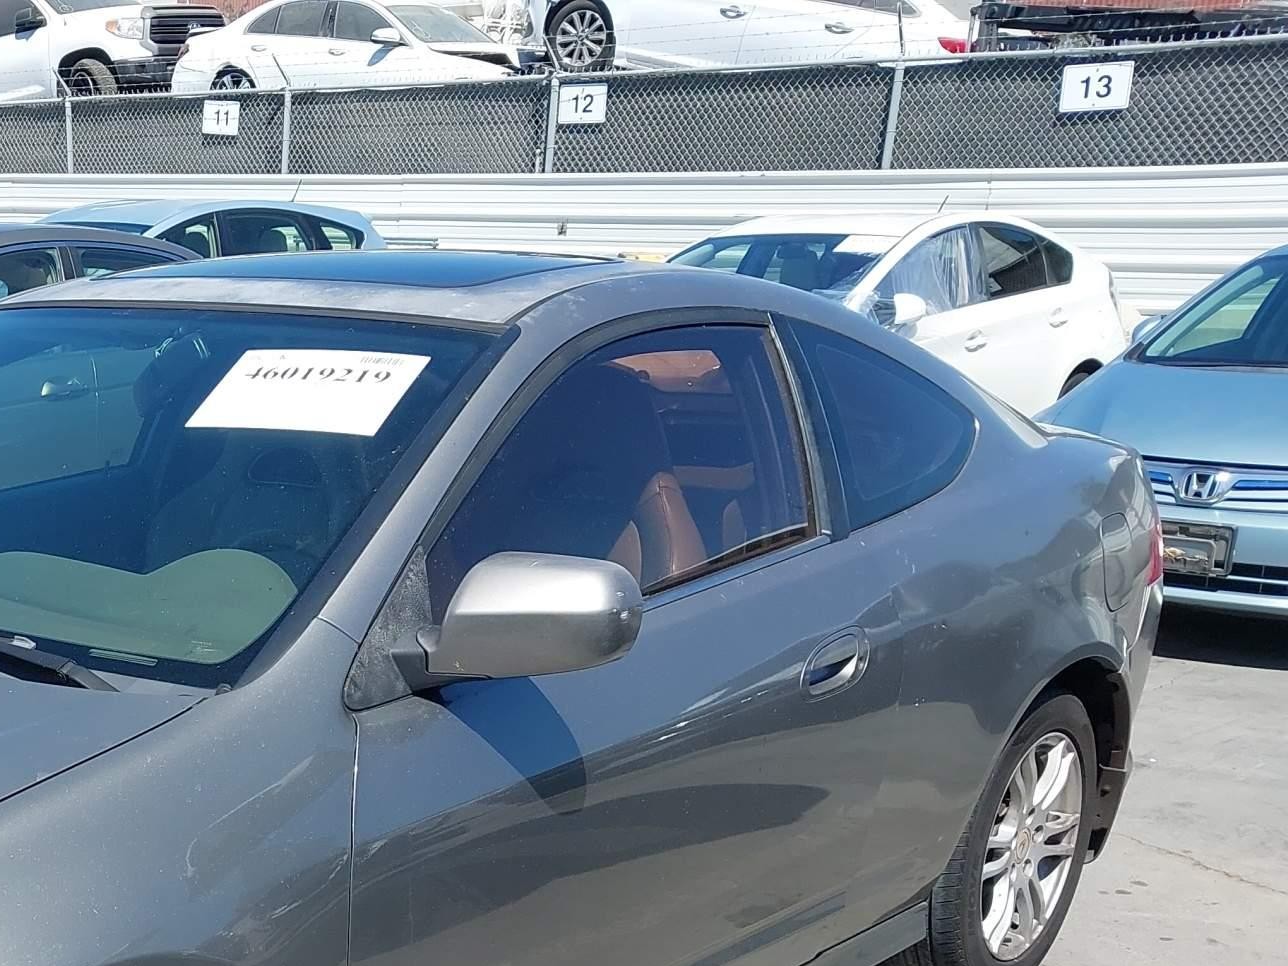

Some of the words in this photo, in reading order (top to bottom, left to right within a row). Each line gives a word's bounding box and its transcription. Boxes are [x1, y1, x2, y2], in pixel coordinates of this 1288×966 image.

[1080, 74, 1113, 99] 13
[572, 94, 594, 113] 12
[213, 109, 230, 127] 11
[244, 365, 393, 384] 46019219
